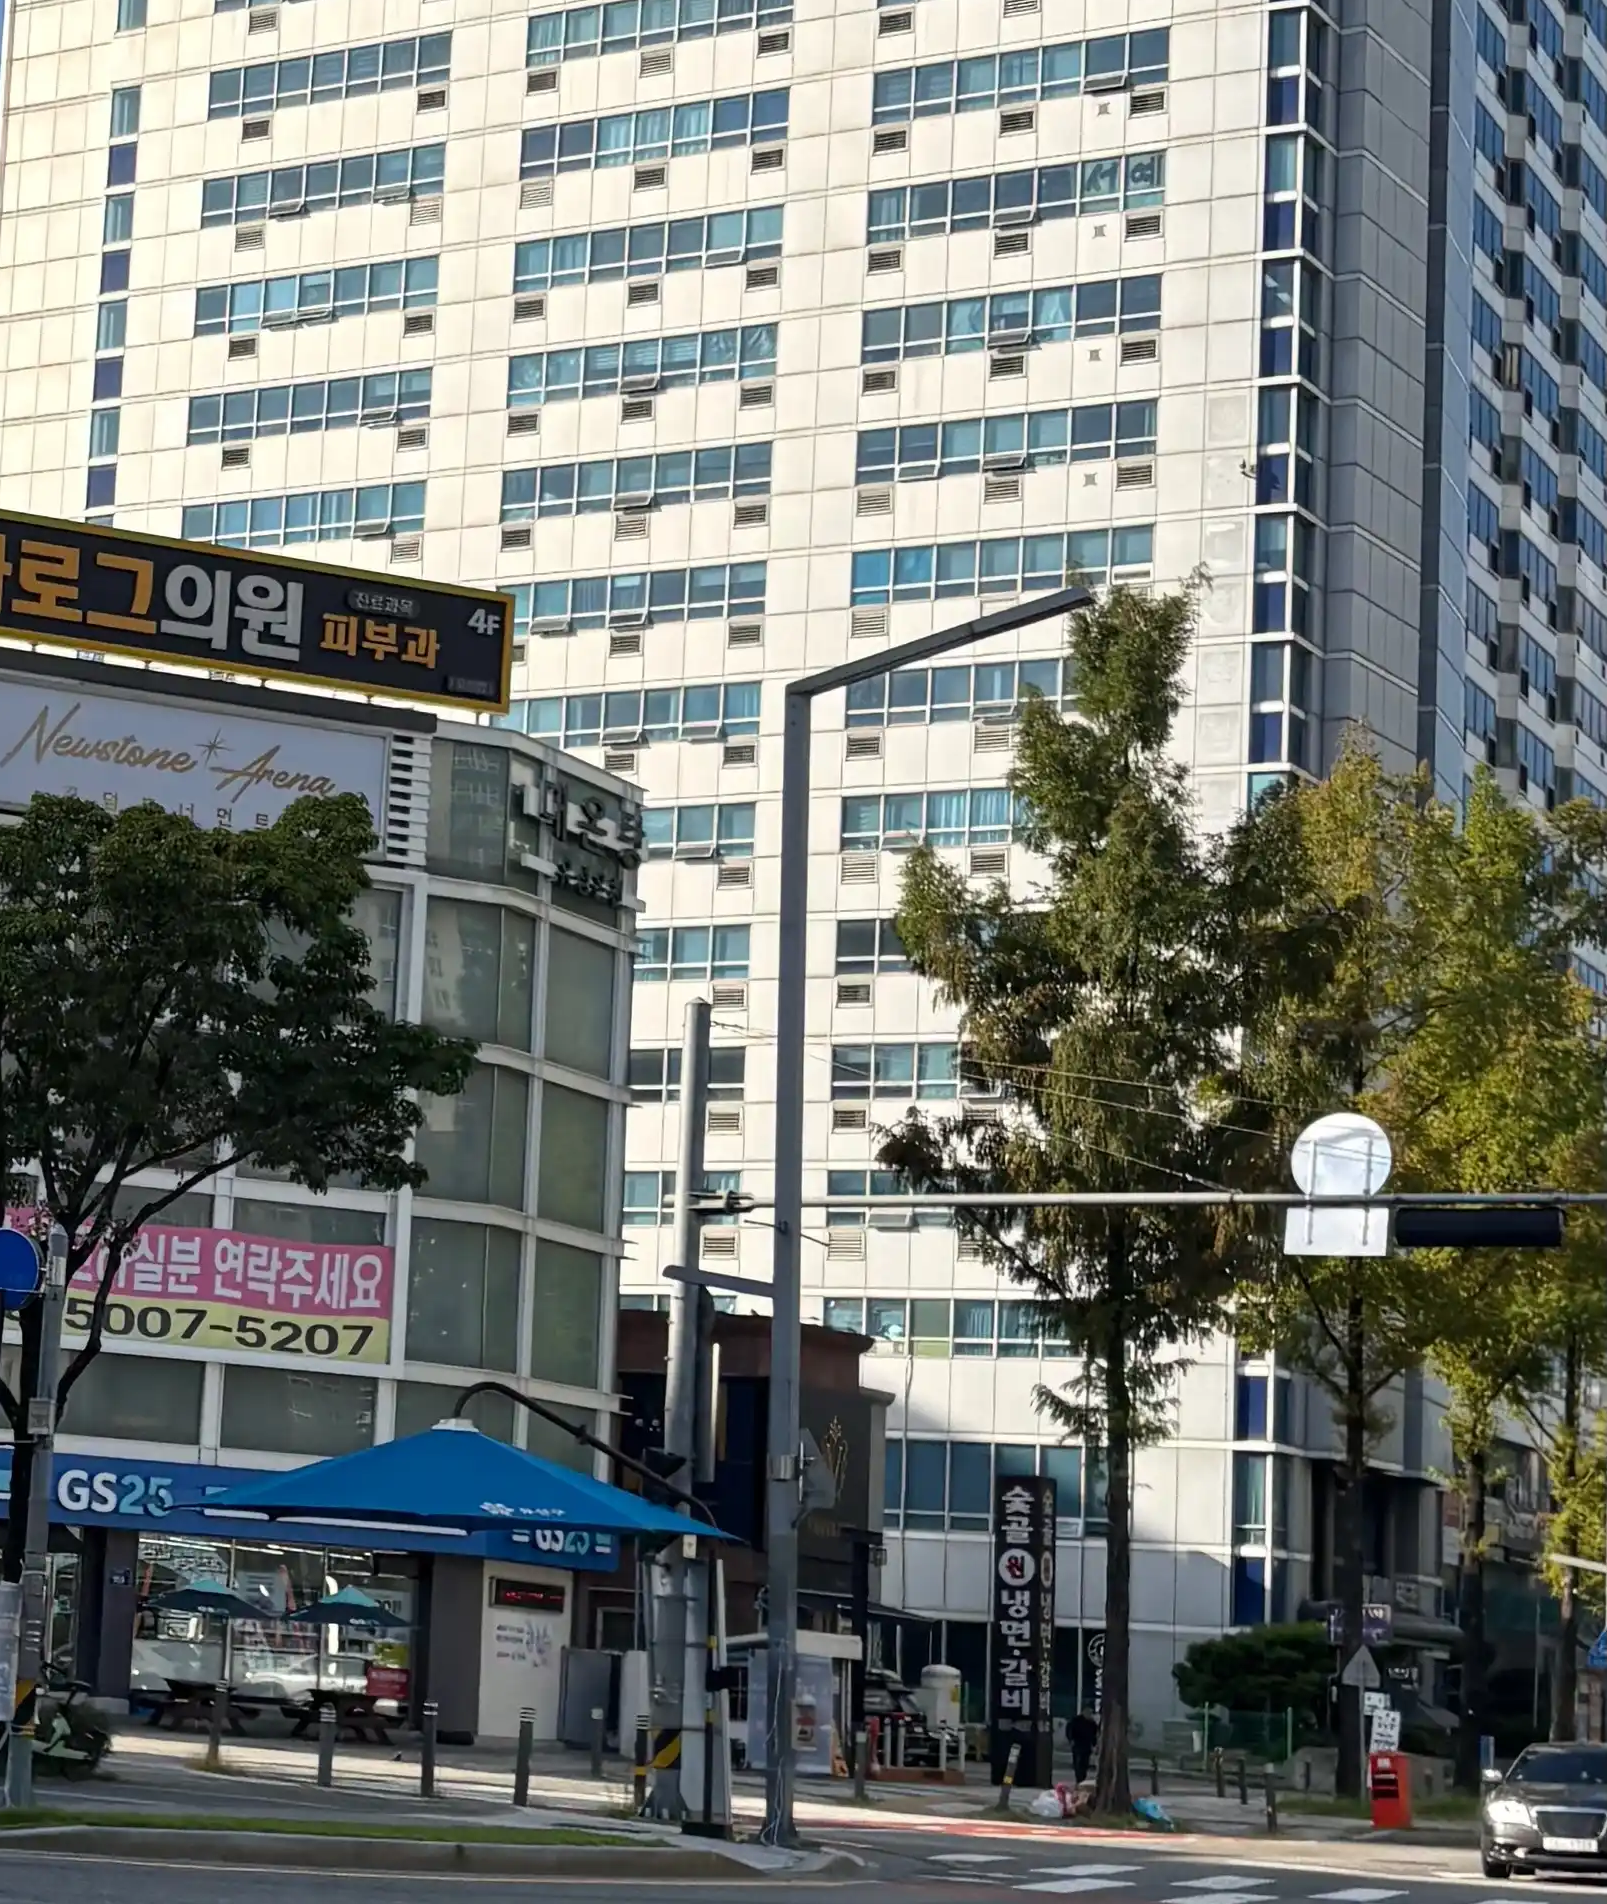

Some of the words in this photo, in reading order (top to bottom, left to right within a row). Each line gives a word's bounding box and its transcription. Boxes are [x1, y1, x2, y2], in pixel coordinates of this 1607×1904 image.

[320, 612, 440, 669] 피부과
[466, 607, 501, 636] 4F
[0, 702, 198, 774] Newstone
[209, 744, 336, 804] Arena
[214, 1237, 383, 1310] 연락주세요
[57, 1469, 173, 1517] GS25
